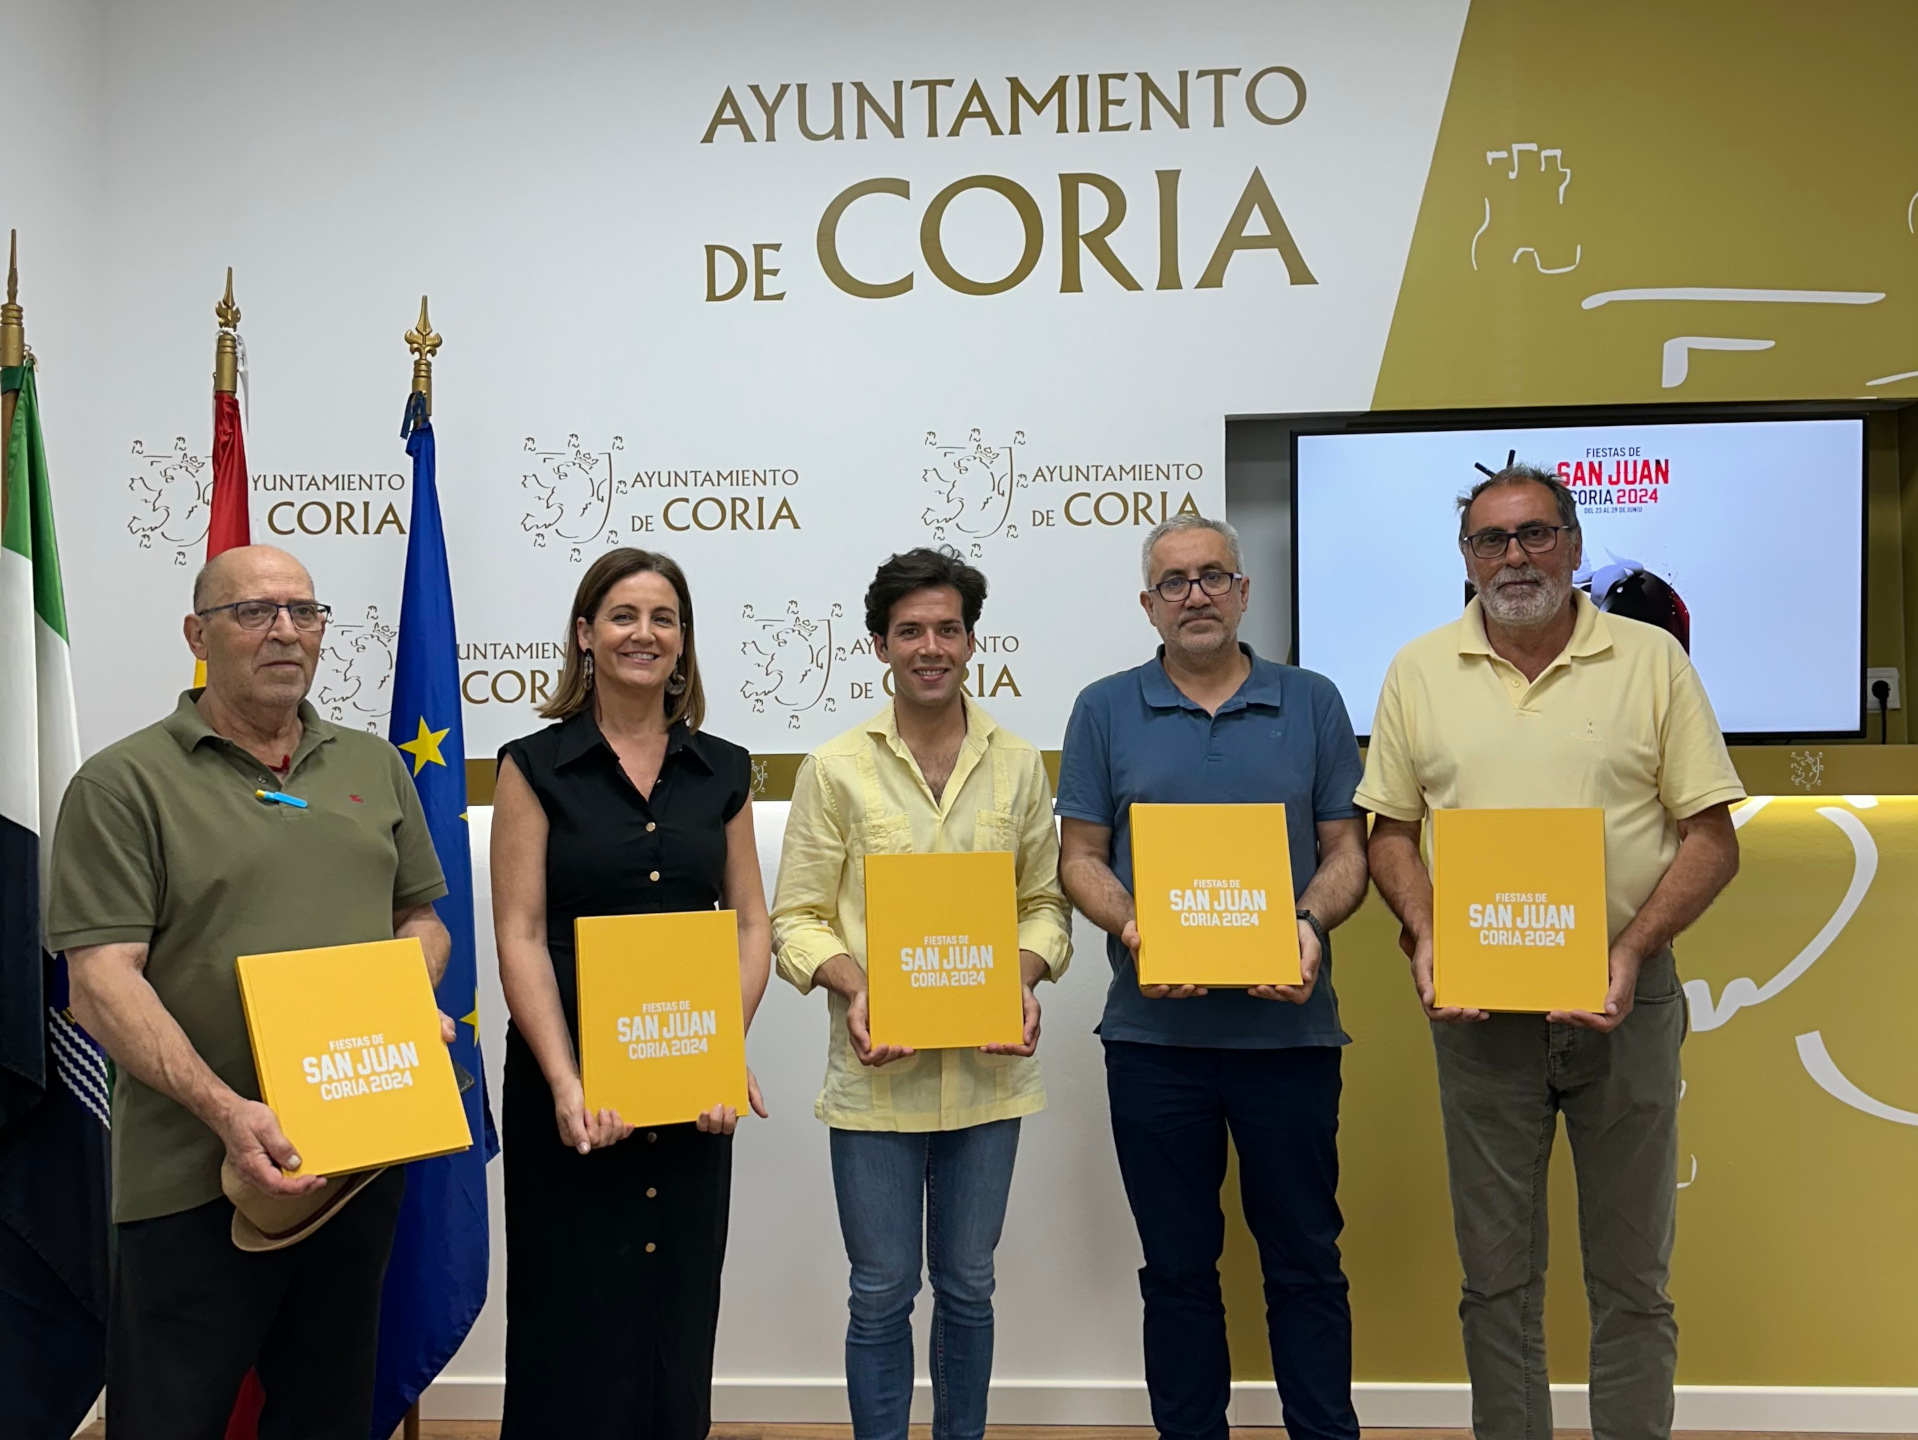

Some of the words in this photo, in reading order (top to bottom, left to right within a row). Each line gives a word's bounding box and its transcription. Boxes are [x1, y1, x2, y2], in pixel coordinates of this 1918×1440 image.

[700, 65, 1307, 144] AYUNTAMIENTO
[704, 243, 787, 301] DE
[816, 166, 1319, 299] CORIA
[1586, 447, 1626, 458] FIESTAS
[1628, 446, 1641, 457] DE
[631, 469, 799, 488] AYUNTAMIENTO
[1032, 463, 1203, 482] AYUNTAMIENTO
[1557, 460, 1603, 487] SAN
[1608, 458, 1669, 486] JUAN
[252, 474, 405, 491] YUNTAMIENTO
[1616, 488, 1658, 504] 2024
[267, 501, 407, 535] CORIA
[631, 515, 654, 532] DE
[662, 496, 801, 532] CORIA
[1032, 510, 1055, 527] DE
[1064, 491, 1200, 527] CORIA
[457, 642, 567, 660] UNTAMIEN
[850, 682, 874, 699] DE
[1193, 879, 1228, 889] FIESTAS
[1229, 879, 1240, 889] DE
[1169, 889, 1210, 911] SAN
[1213, 889, 1267, 911] JUAN
[1495, 892, 1533, 903] FIESTAS
[1535, 893, 1548, 903] DE
[1181, 912, 1221, 927] CORIA
[1222, 912, 1260, 927] 2024
[1469, 903, 1512, 928] SAN
[1516, 904, 1575, 929] JUAN
[924, 935, 957, 945] FIESTAS
[959, 935, 969, 944] DE
[1480, 929, 1523, 945] CORIA
[1524, 930, 1565, 946] 2024
[901, 946, 940, 971] SAN
[943, 945, 994, 969] JUAN
[911, 972, 949, 988] CORIA
[950, 970, 985, 986] 2024
[642, 1001, 678, 1013] FIESTAS
[679, 1000, 691, 1010] DE
[617, 1014, 659, 1042] SAN
[662, 1010, 716, 1039] JUAN
[329, 1035, 371, 1051] FIESTAS
[371, 1033, 385, 1045] DE
[628, 1041, 670, 1060] CORIA
[671, 1037, 708, 1056] 2024
[302, 1051, 354, 1084] SAN
[356, 1041, 419, 1075] JUAN
[321, 1078, 370, 1101] CORIA
[369, 1070, 413, 1093] 2024
